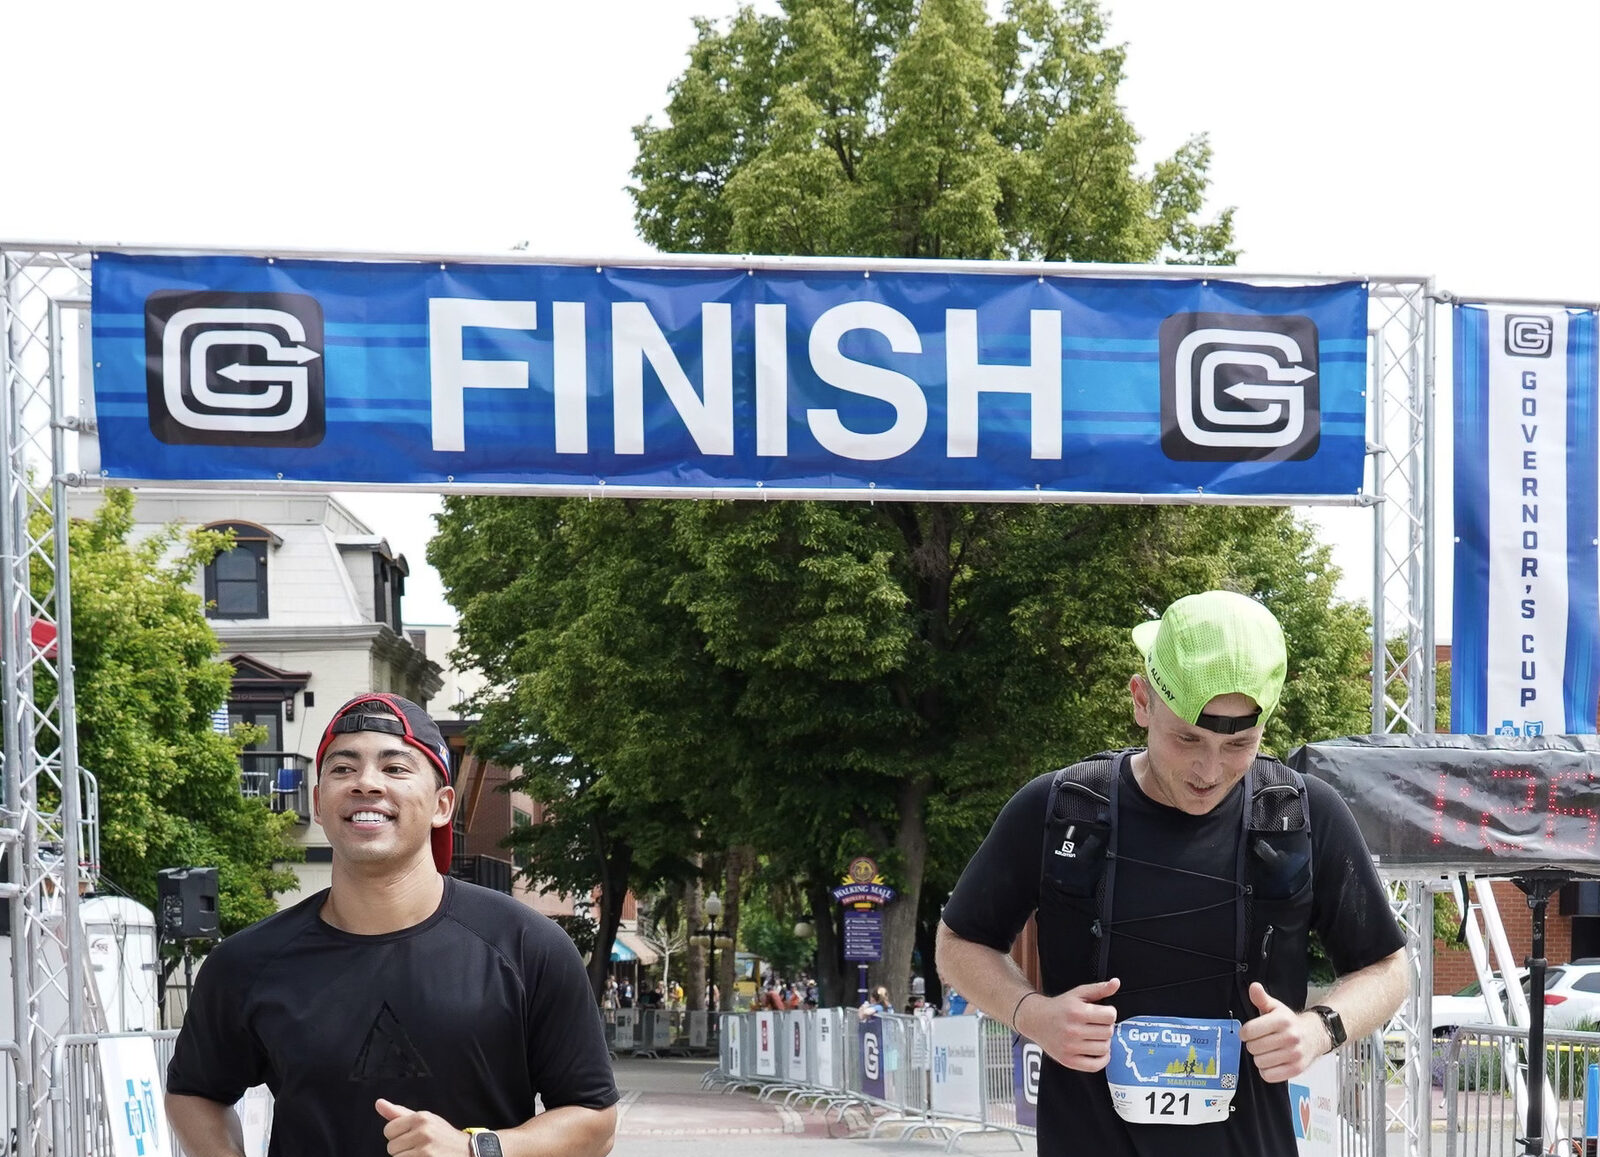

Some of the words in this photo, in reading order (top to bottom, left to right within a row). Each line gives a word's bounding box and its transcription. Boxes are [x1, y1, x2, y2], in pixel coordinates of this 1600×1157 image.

[428, 297, 1062, 461] FINISH
[1520, 370, 1539, 619] GOVERNOR'S
[1519, 633, 1537, 708] CUP
[1161, 684, 1175, 701] DAY
[833, 885, 869, 899] WALKING
[870, 885, 892, 899] MALL
[1128, 1028, 1159, 1042] Gov
[1161, 1029, 1191, 1047] Cup
[1167, 1078, 1207, 1086] MARATHON
[1145, 1091, 1190, 1116] 121
